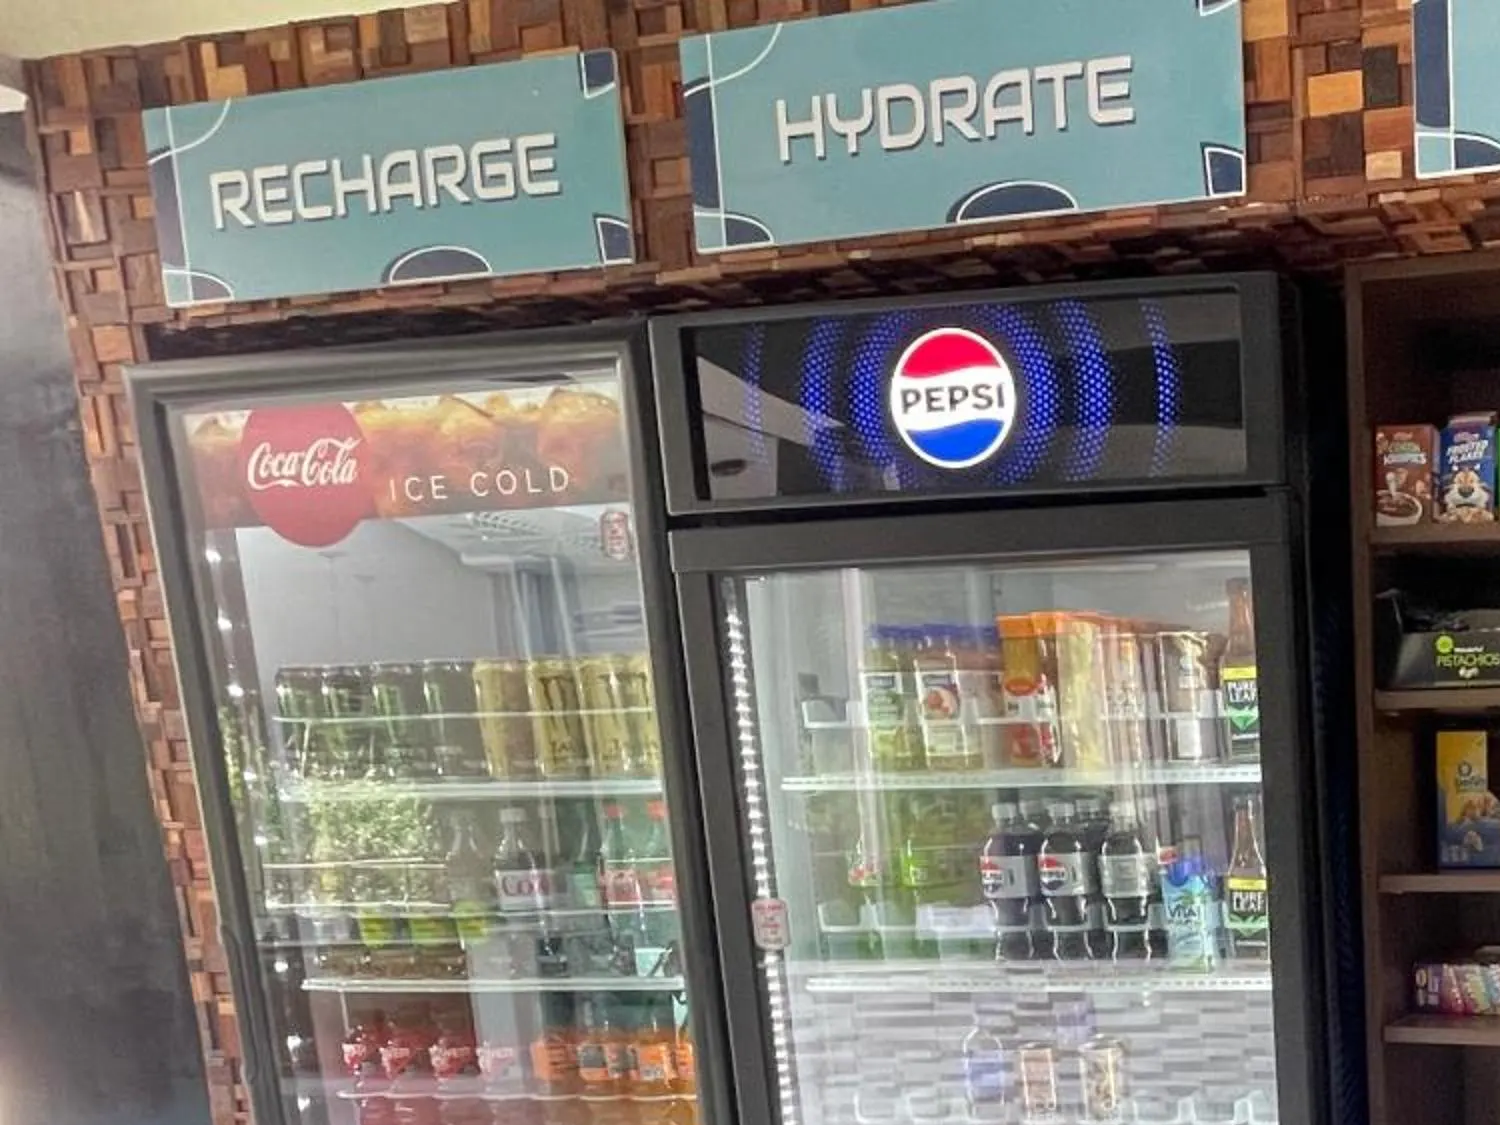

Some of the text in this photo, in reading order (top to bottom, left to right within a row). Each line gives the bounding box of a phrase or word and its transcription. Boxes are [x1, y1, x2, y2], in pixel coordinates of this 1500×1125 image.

[775, 55, 1137, 163] HYDRATE
[209, 133, 562, 231] RECHARGE
[900, 382, 1005, 415] PEPSI
[389, 466, 569, 502] ICE COLD
